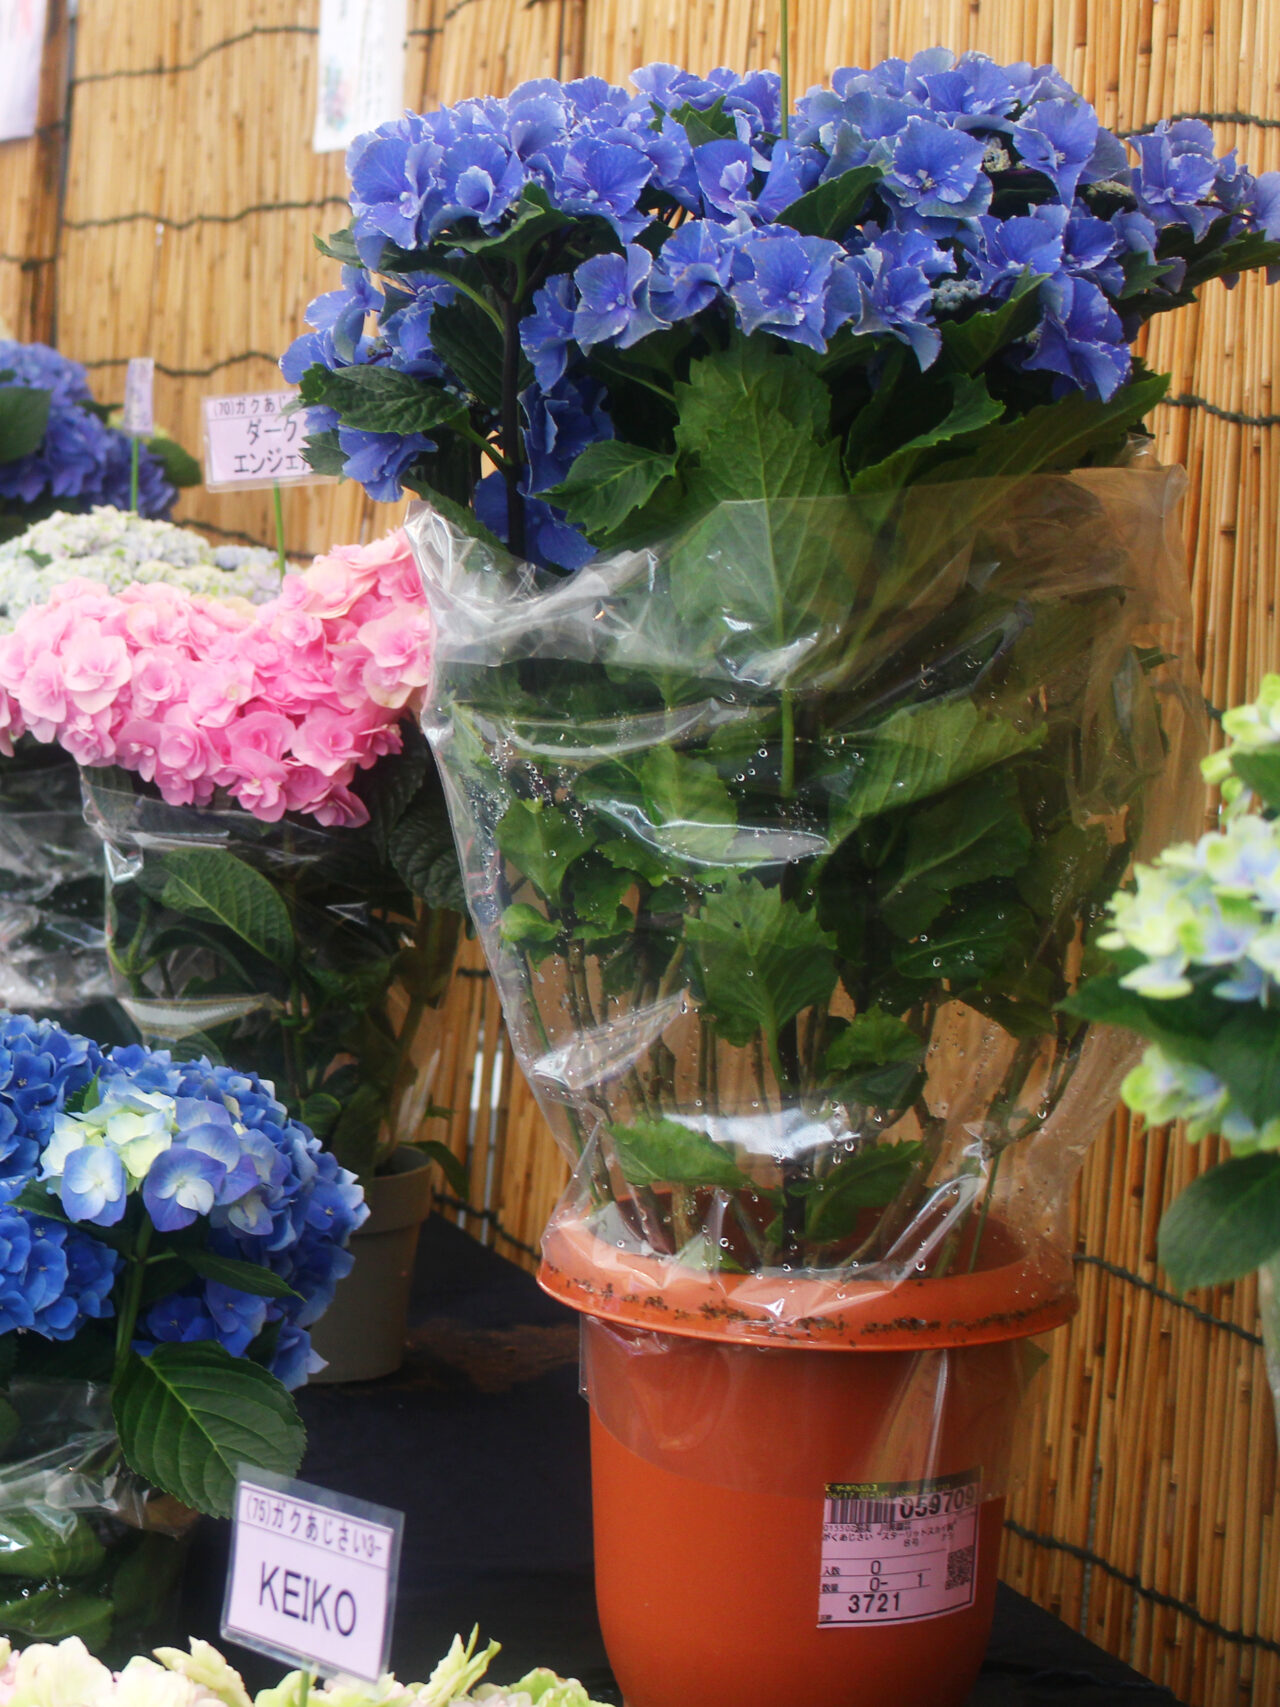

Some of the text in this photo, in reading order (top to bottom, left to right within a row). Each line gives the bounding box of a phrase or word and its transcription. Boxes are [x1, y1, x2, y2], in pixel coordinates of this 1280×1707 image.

[246, 418, 298, 446] ダーク
[258, 1560, 358, 1638] KEIKO
[848, 1592, 901, 1614] 3721
